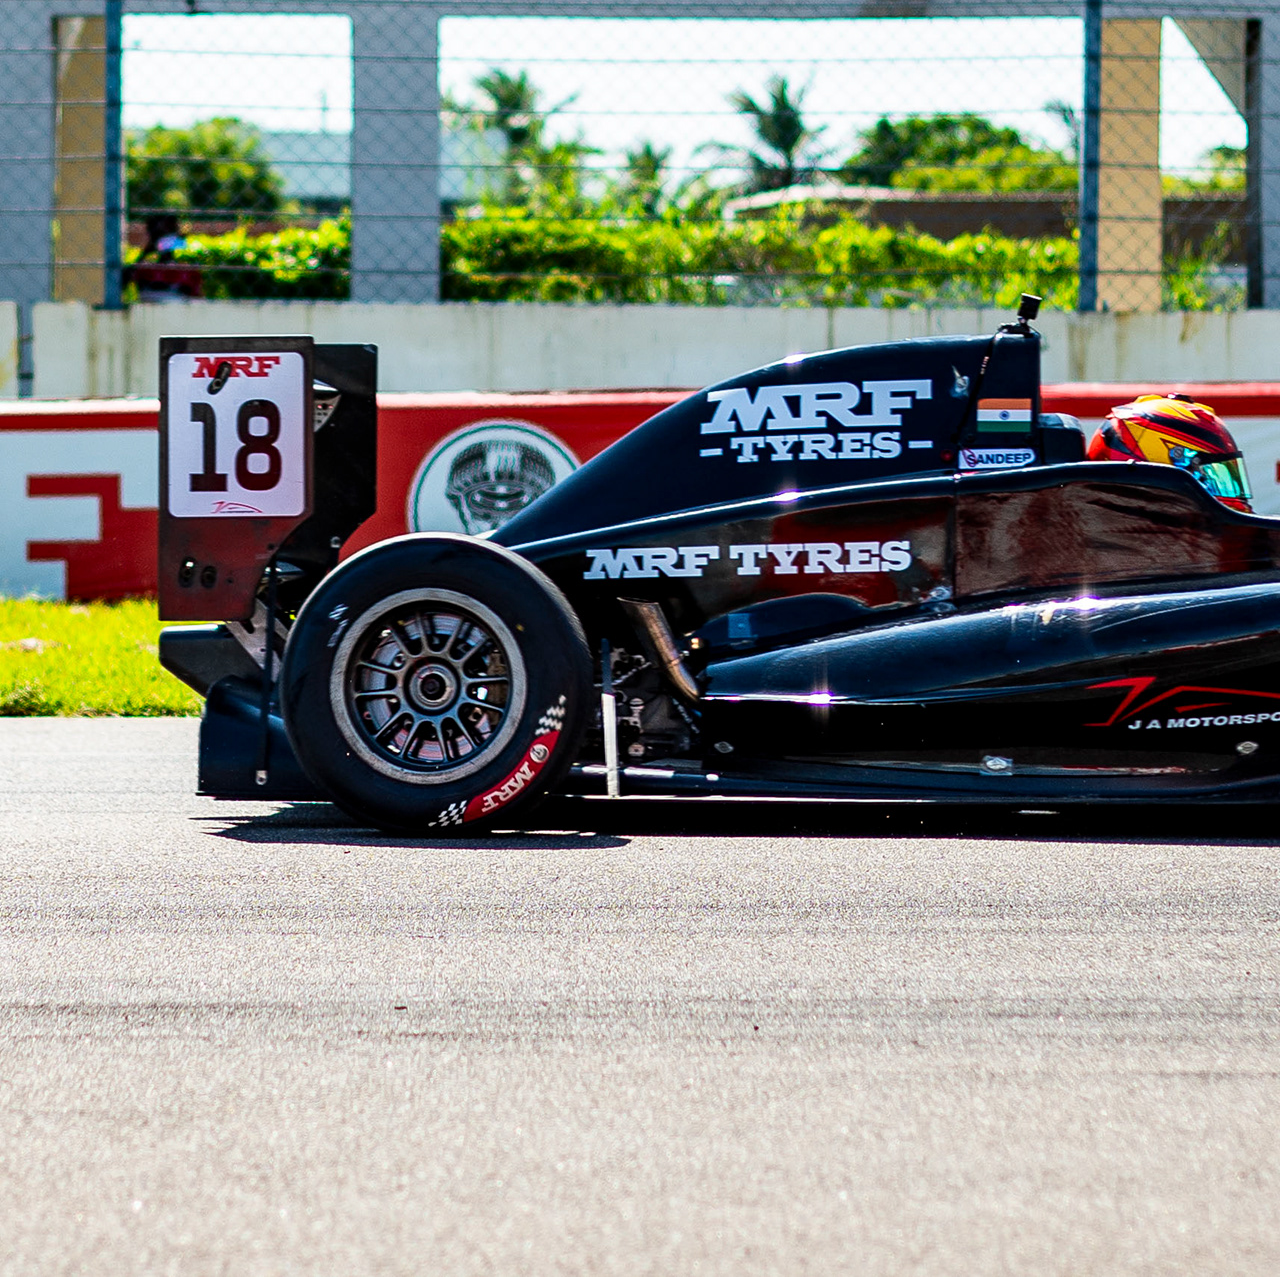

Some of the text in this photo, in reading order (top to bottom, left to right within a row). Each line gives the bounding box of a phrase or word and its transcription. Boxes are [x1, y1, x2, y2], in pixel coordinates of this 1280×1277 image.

[192, 356, 281, 378] MRF
[700, 379, 932, 434] MRF
[189, 399, 282, 492] 18
[967, 453, 1032, 465] SANDEEP
[583, 541, 912, 579] MRF TYRES
[481, 761, 535, 812] MRF
